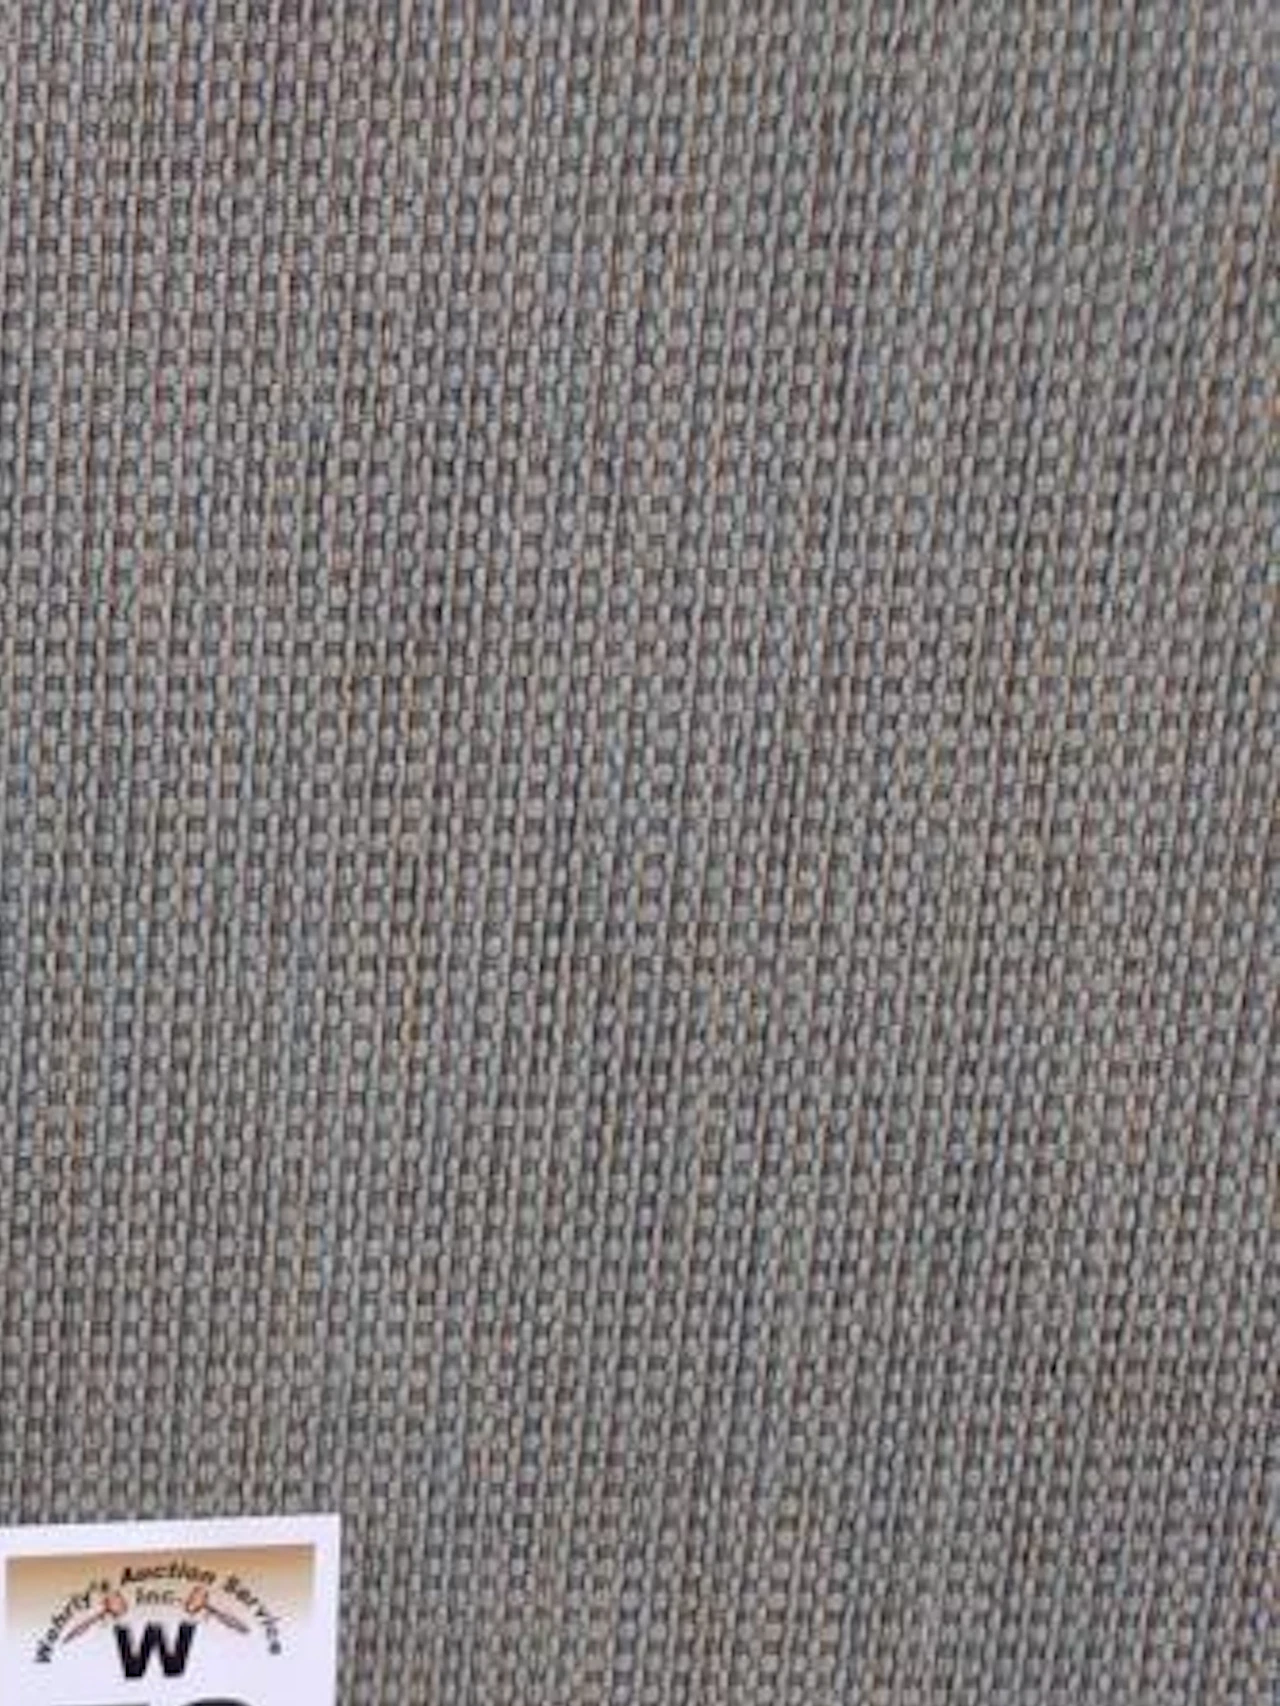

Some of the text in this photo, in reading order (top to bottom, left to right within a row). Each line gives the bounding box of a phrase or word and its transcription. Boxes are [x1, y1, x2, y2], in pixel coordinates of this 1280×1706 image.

[120, 1559, 217, 1588] Auction
[223, 1573, 283, 1657] Service
[112, 1620, 198, 1680] W
